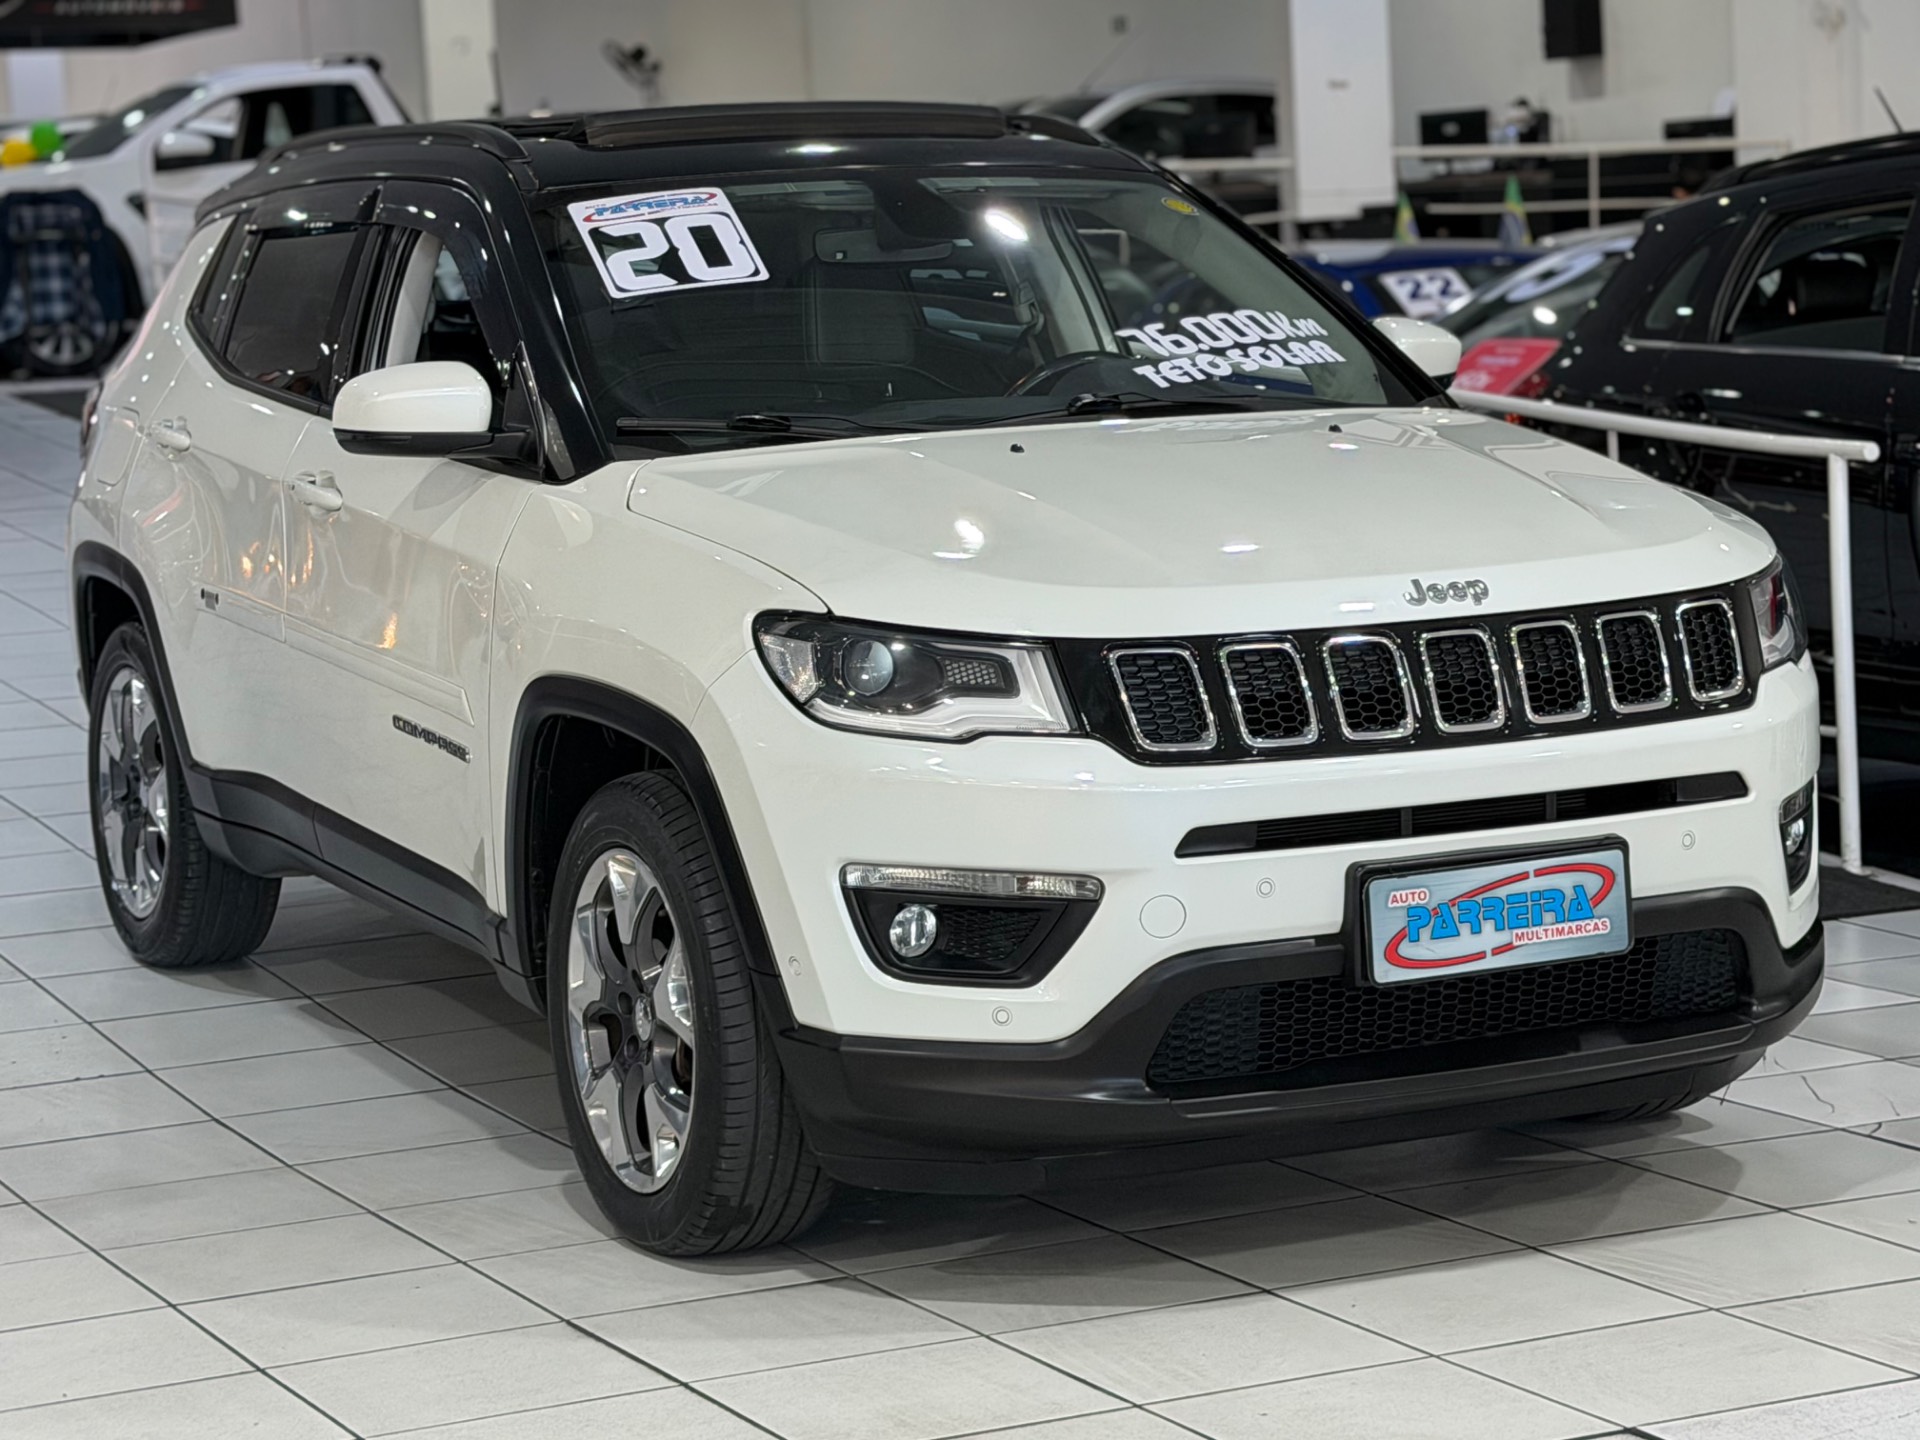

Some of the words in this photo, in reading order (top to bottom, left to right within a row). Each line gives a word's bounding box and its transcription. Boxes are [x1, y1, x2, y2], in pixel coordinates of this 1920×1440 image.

[594, 196, 709, 217] PARREIRA
[598, 213, 756, 291] 20
[1397, 274, 1463, 300] 22
[1132, 353, 1233, 388] TETO
[1225, 340, 1347, 372] SOLAR
[1402, 578, 1490, 607] Jeep
[392, 714, 471, 764] COMPASS
[1390, 890, 1428, 905] AUTO
[1406, 885, 1595, 943] PARREIRA
[1513, 920, 1609, 943] MULTIMARCAS
